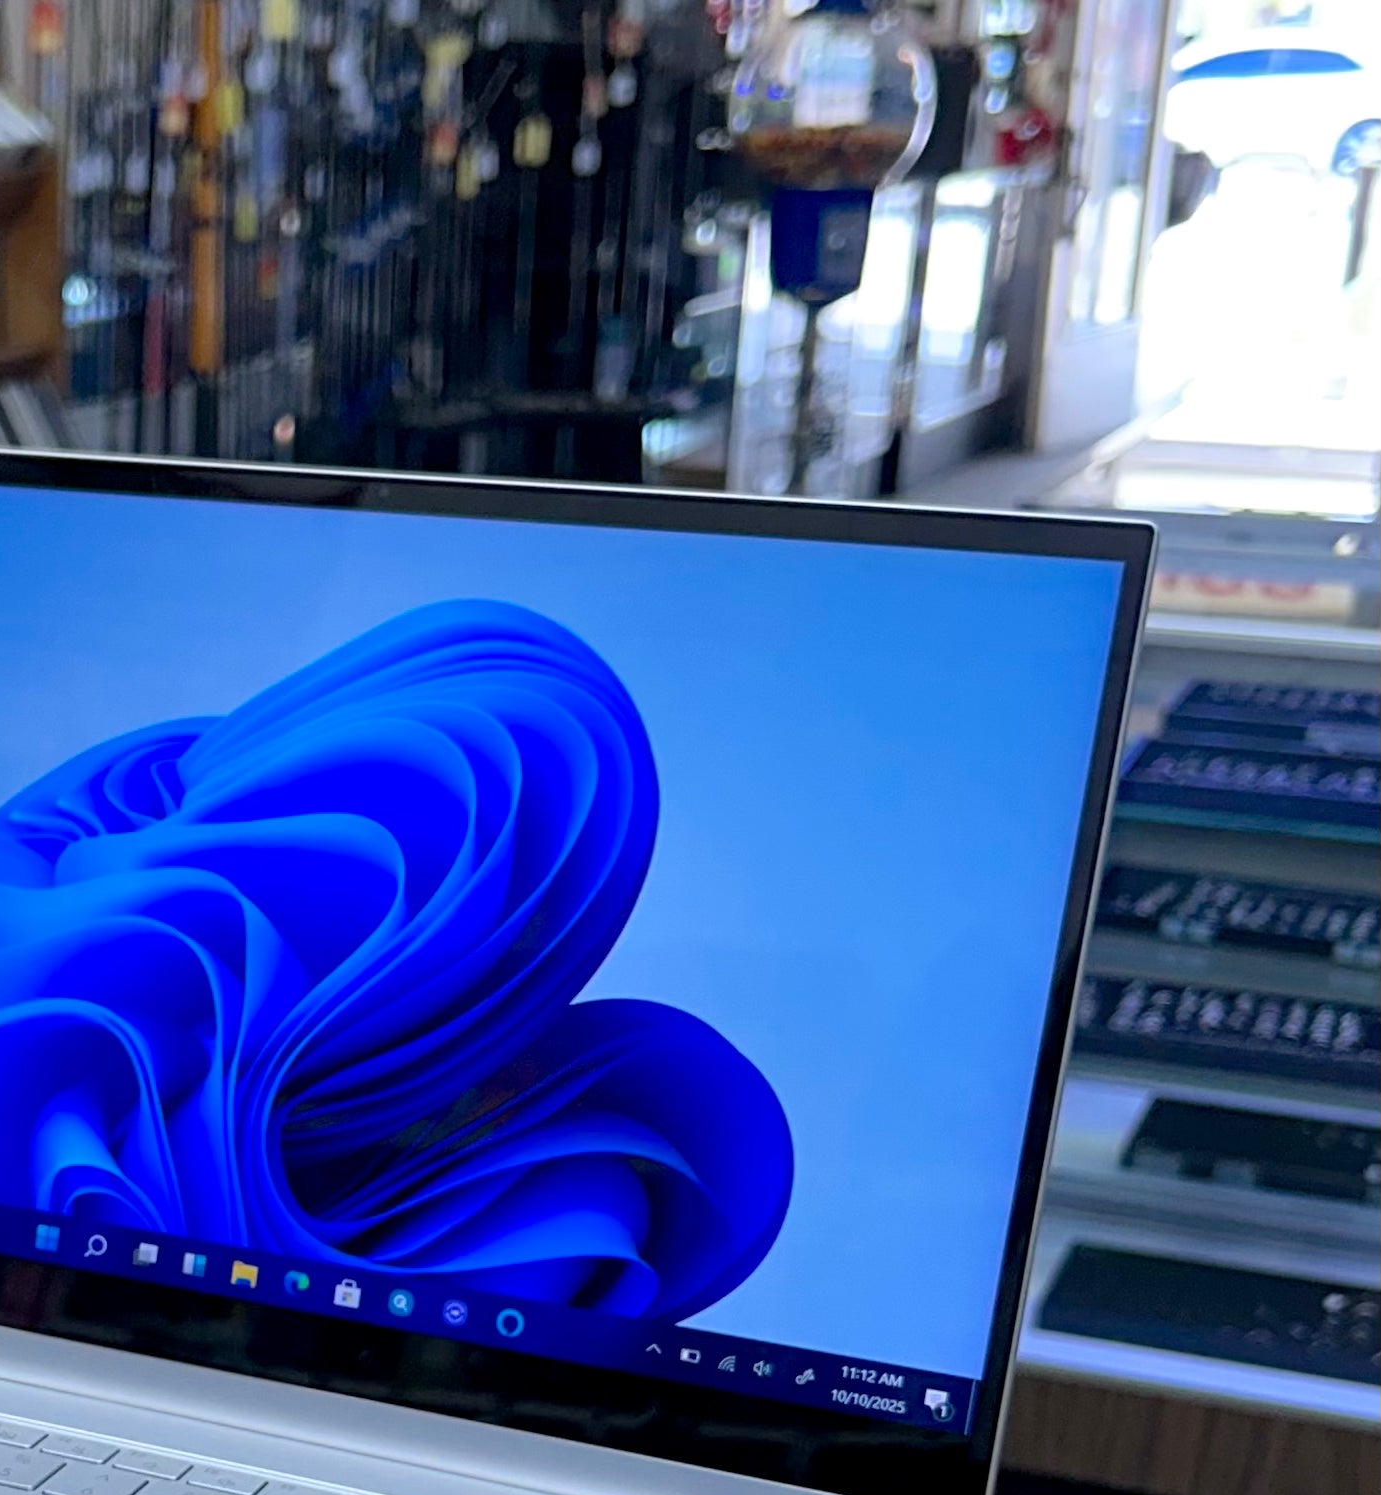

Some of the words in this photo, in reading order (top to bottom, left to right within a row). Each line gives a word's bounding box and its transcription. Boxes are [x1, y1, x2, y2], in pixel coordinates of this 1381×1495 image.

[841, 1365, 877, 1383] 11:12
[878, 1372, 905, 1388] AM
[830, 1389, 906, 1414] 10/10/2025
